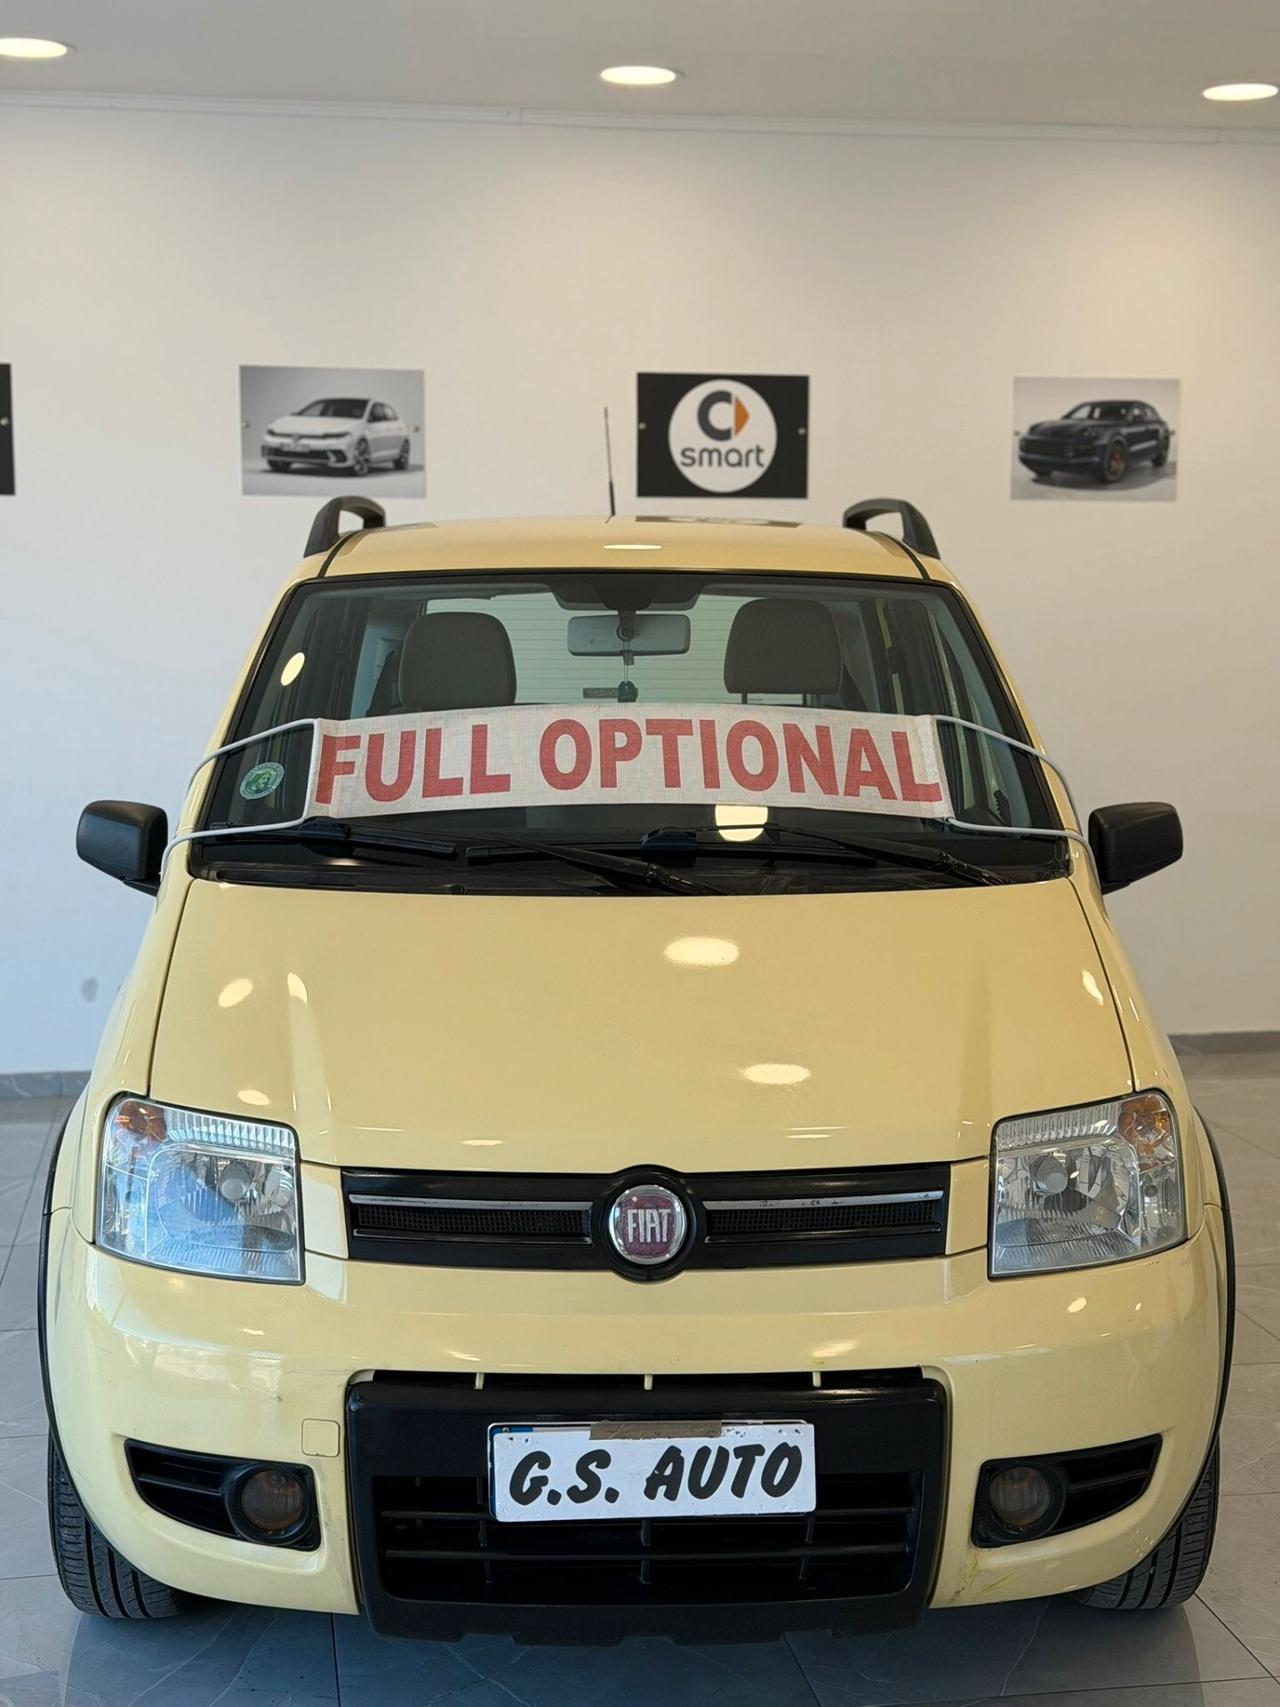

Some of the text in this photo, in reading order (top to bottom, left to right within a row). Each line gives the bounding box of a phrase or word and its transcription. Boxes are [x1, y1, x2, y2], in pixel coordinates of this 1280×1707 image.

[680, 445, 765, 468] smart
[315, 724, 511, 804] FULL
[539, 718, 942, 803] OPTIONAL
[627, 1208, 672, 1243] FIAT
[509, 1442, 802, 1505] G.S. AUTO
